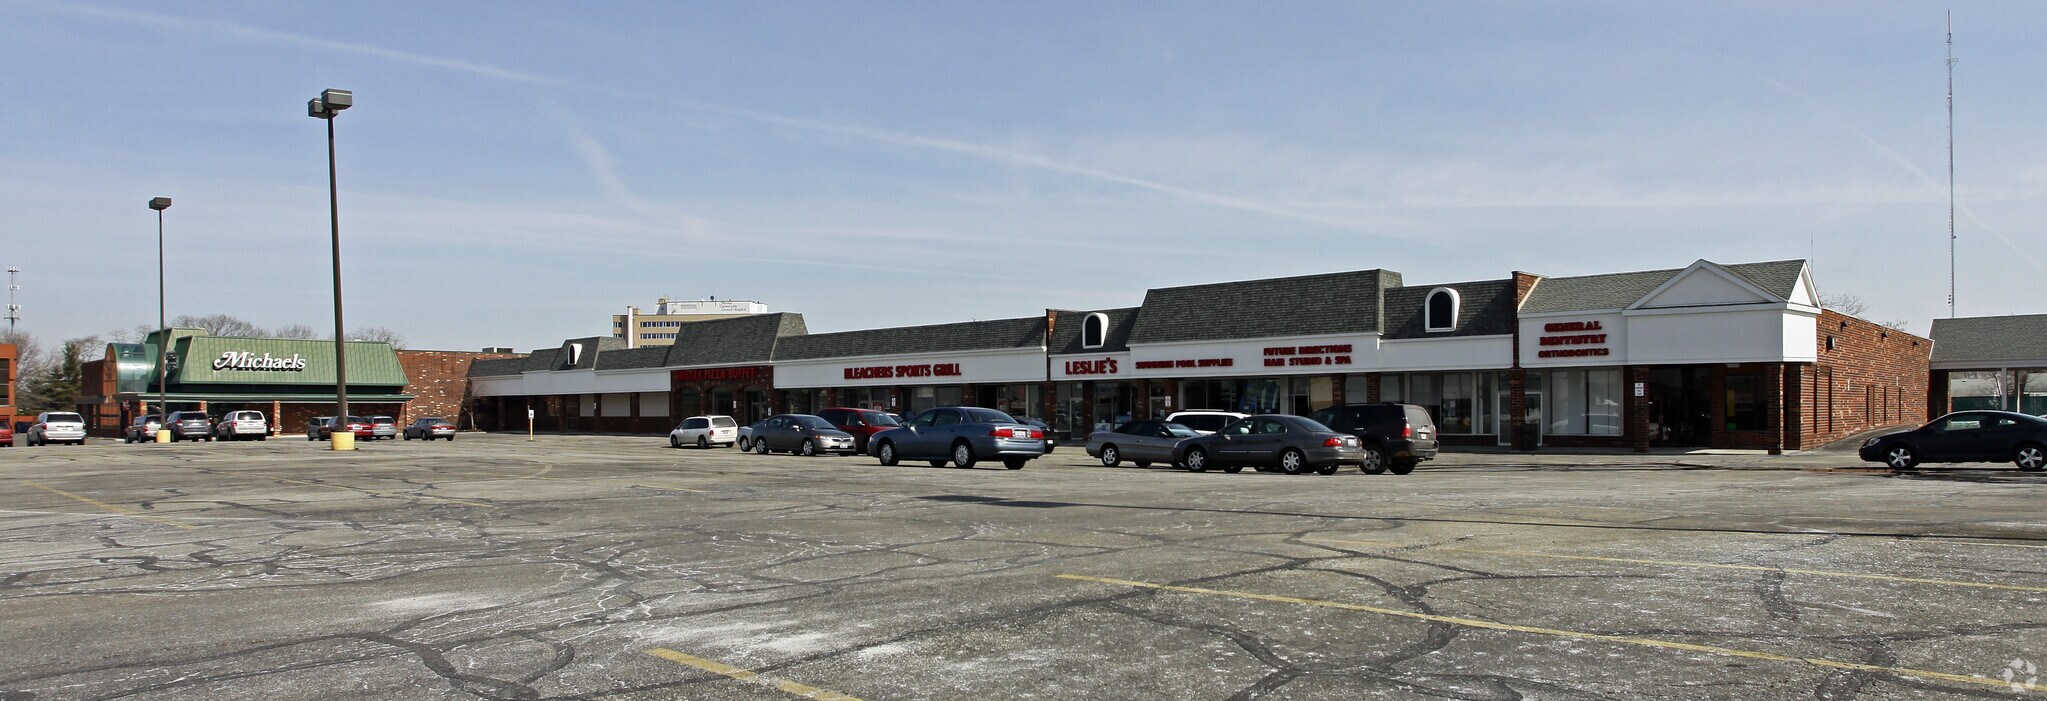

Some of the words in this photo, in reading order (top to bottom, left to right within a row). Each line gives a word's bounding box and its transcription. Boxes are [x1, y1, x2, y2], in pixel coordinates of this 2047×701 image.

[1263, 347, 1296, 355] FUTURE
[1298, 344, 1352, 355] DIRECTIONS
[1538, 348, 1609, 358] ORTHODONTICS
[213, 351, 306, 371] Michaels
[1065, 357, 1118, 375] LESLIE'S
[1175, 359, 1196, 368] POOL
[1198, 358, 1233, 367] SUPPLIES
[1288, 357, 1322, 366] STUDIO
[1325, 356, 1332, 365] &
[1334, 355, 1352, 364] SPA
[704, 368, 726, 379] PIZZA
[728, 367, 756, 379] BUFFET
[844, 366, 894, 380] BLEACHERS
[895, 364, 931, 378] SPORTS
[933, 363, 962, 376] GRILL
